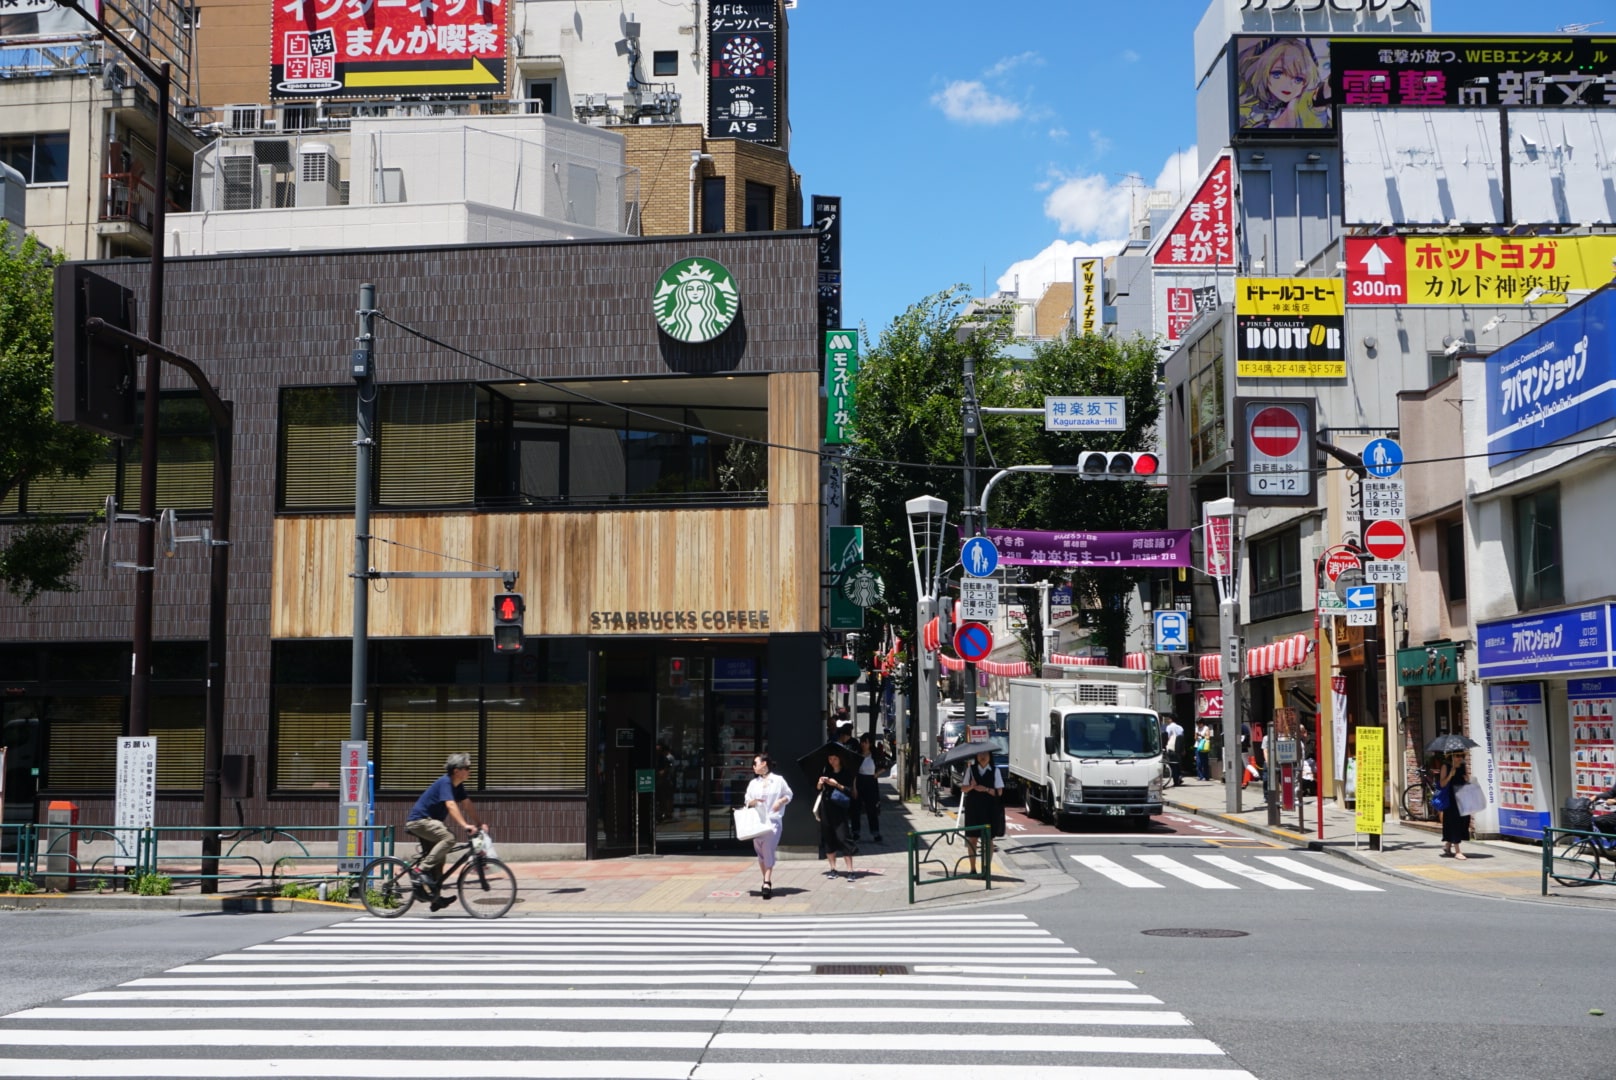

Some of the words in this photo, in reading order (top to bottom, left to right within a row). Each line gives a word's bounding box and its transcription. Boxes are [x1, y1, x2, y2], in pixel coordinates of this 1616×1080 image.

[346, 24, 498, 56] まんが喫茶
[729, 121, 757, 133] A's
[1212, 169, 1229, 262] インターネット
[1189, 201, 1213, 262] まんが
[1170, 233, 1187, 263] 喫茶
[1415, 241, 1558, 270] ホットヨガ
[1081, 260, 1097, 337] マツモトキヨ
[1247, 285, 1335, 302] ドトールコーヒー
[1352, 280, 1402, 297] 300m
[1272, 303, 1311, 313] 神楽坂店
[1246, 324, 1341, 350] DOUTOR
[1521, 340, 1555, 364] Communication
[1501, 335, 1589, 416] アパマンショップ
[833, 352, 851, 439] モスバーガー
[1052, 401, 1119, 416] 神楽坂下
[1053, 417, 1118, 427] Kagurazaka-Hill
[1030, 549, 1122, 565] 神楽坂まつり
[591, 611, 697, 625] STARBUCKS
[701, 610, 769, 625] COFFEE
[1512, 623, 1563, 653] アパマンショップ
[123, 741, 150, 749] お願い
